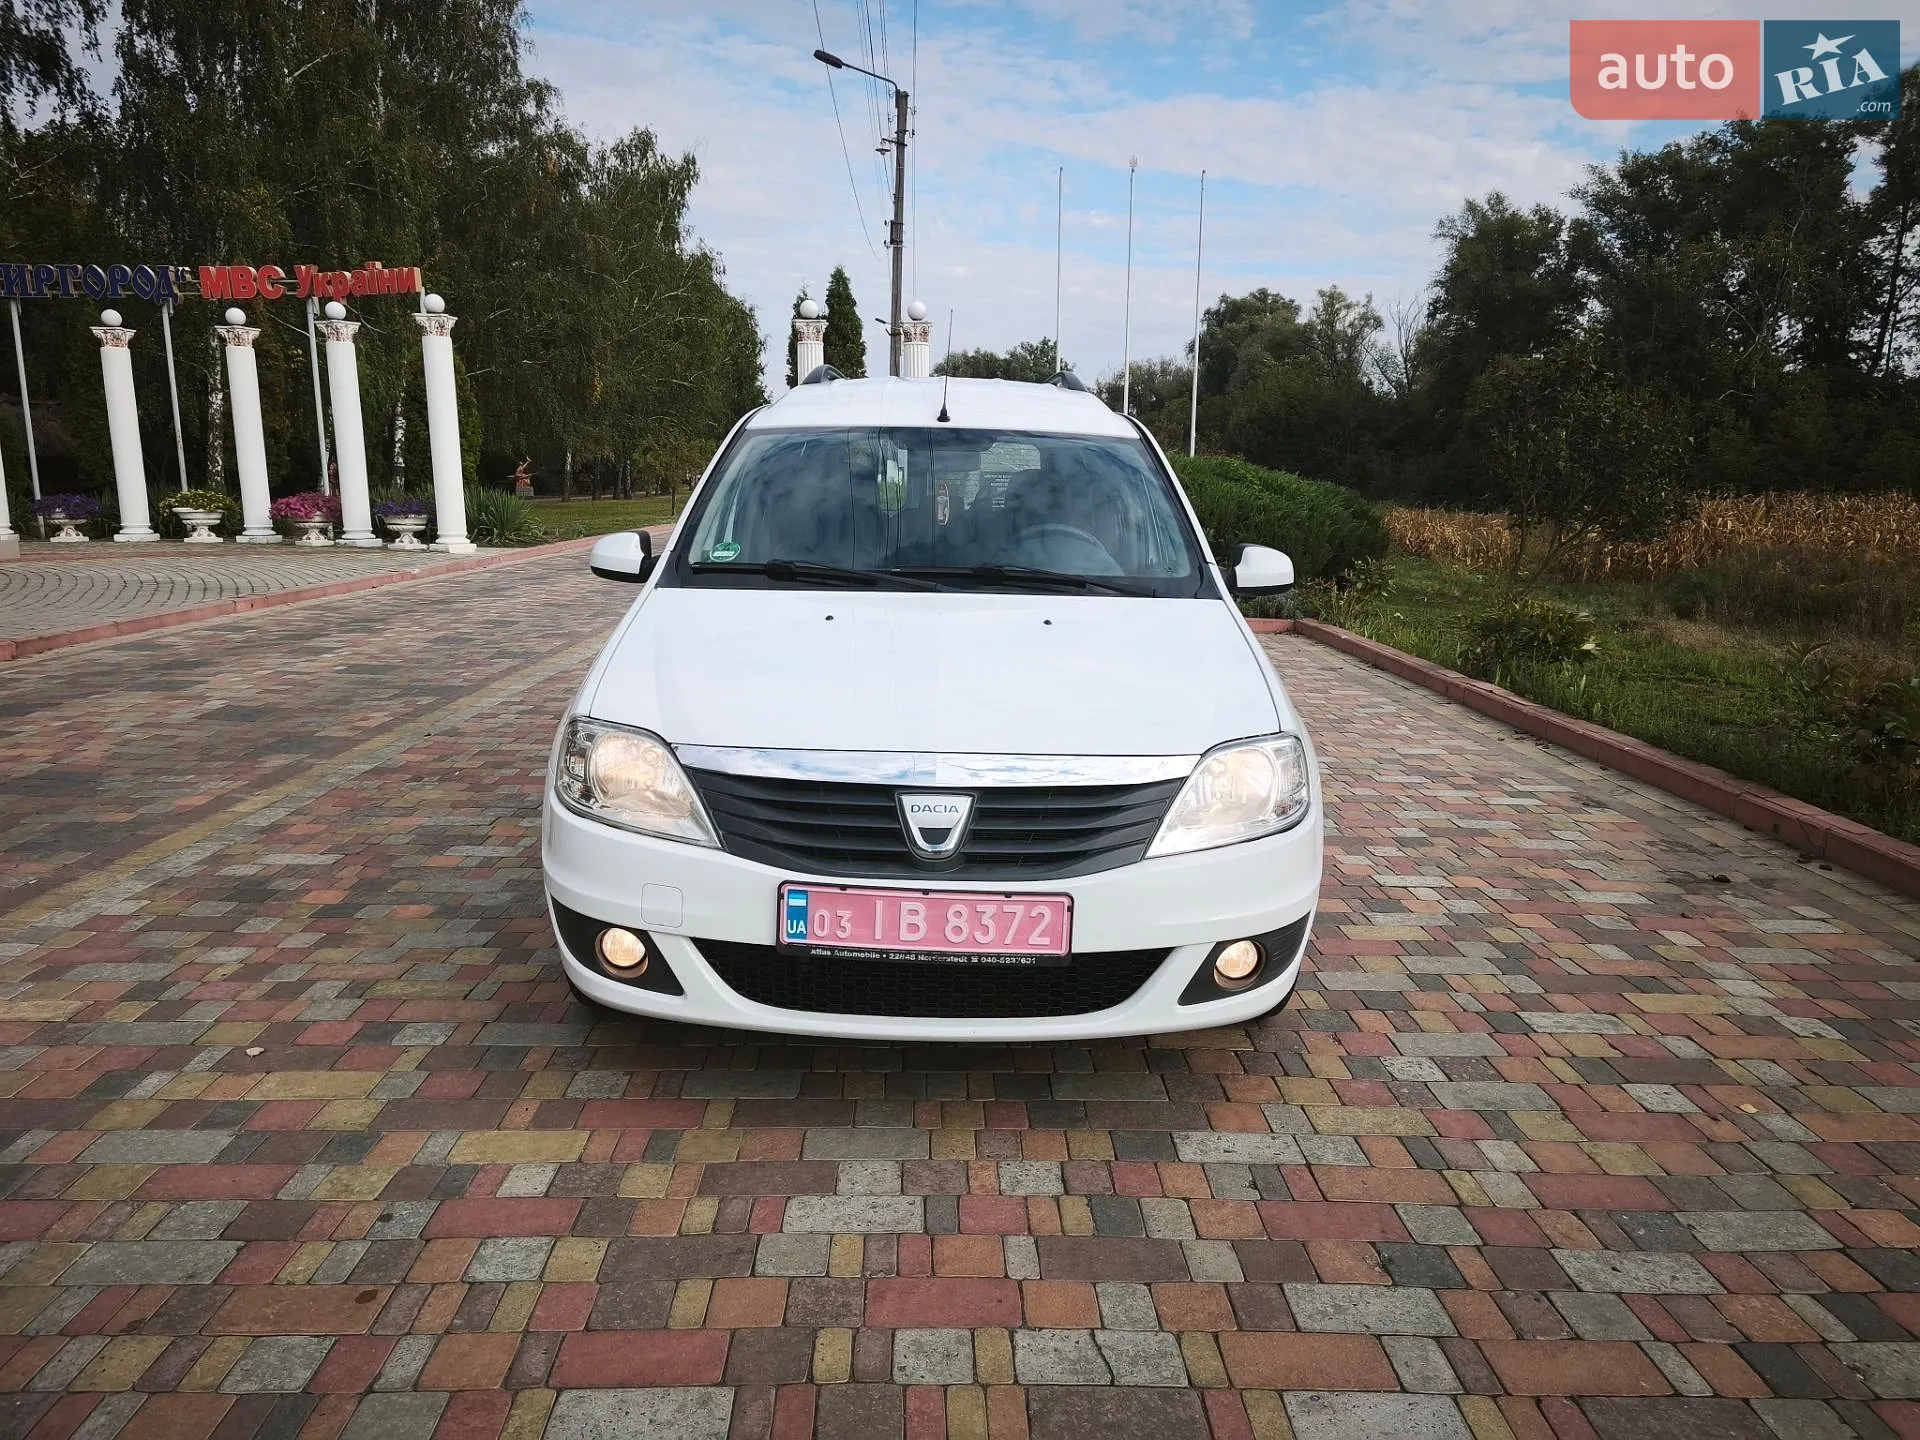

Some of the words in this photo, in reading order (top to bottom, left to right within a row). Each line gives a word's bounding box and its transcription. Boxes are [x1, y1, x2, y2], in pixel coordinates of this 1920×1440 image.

[199, 265, 287, 300] МВС
[292, 261, 421, 305] України
[910, 804, 960, 814] DACIA
[787, 918, 807, 935] UA
[812, 908, 852, 939] 03
[944, 903, 1050, 946] 8372
